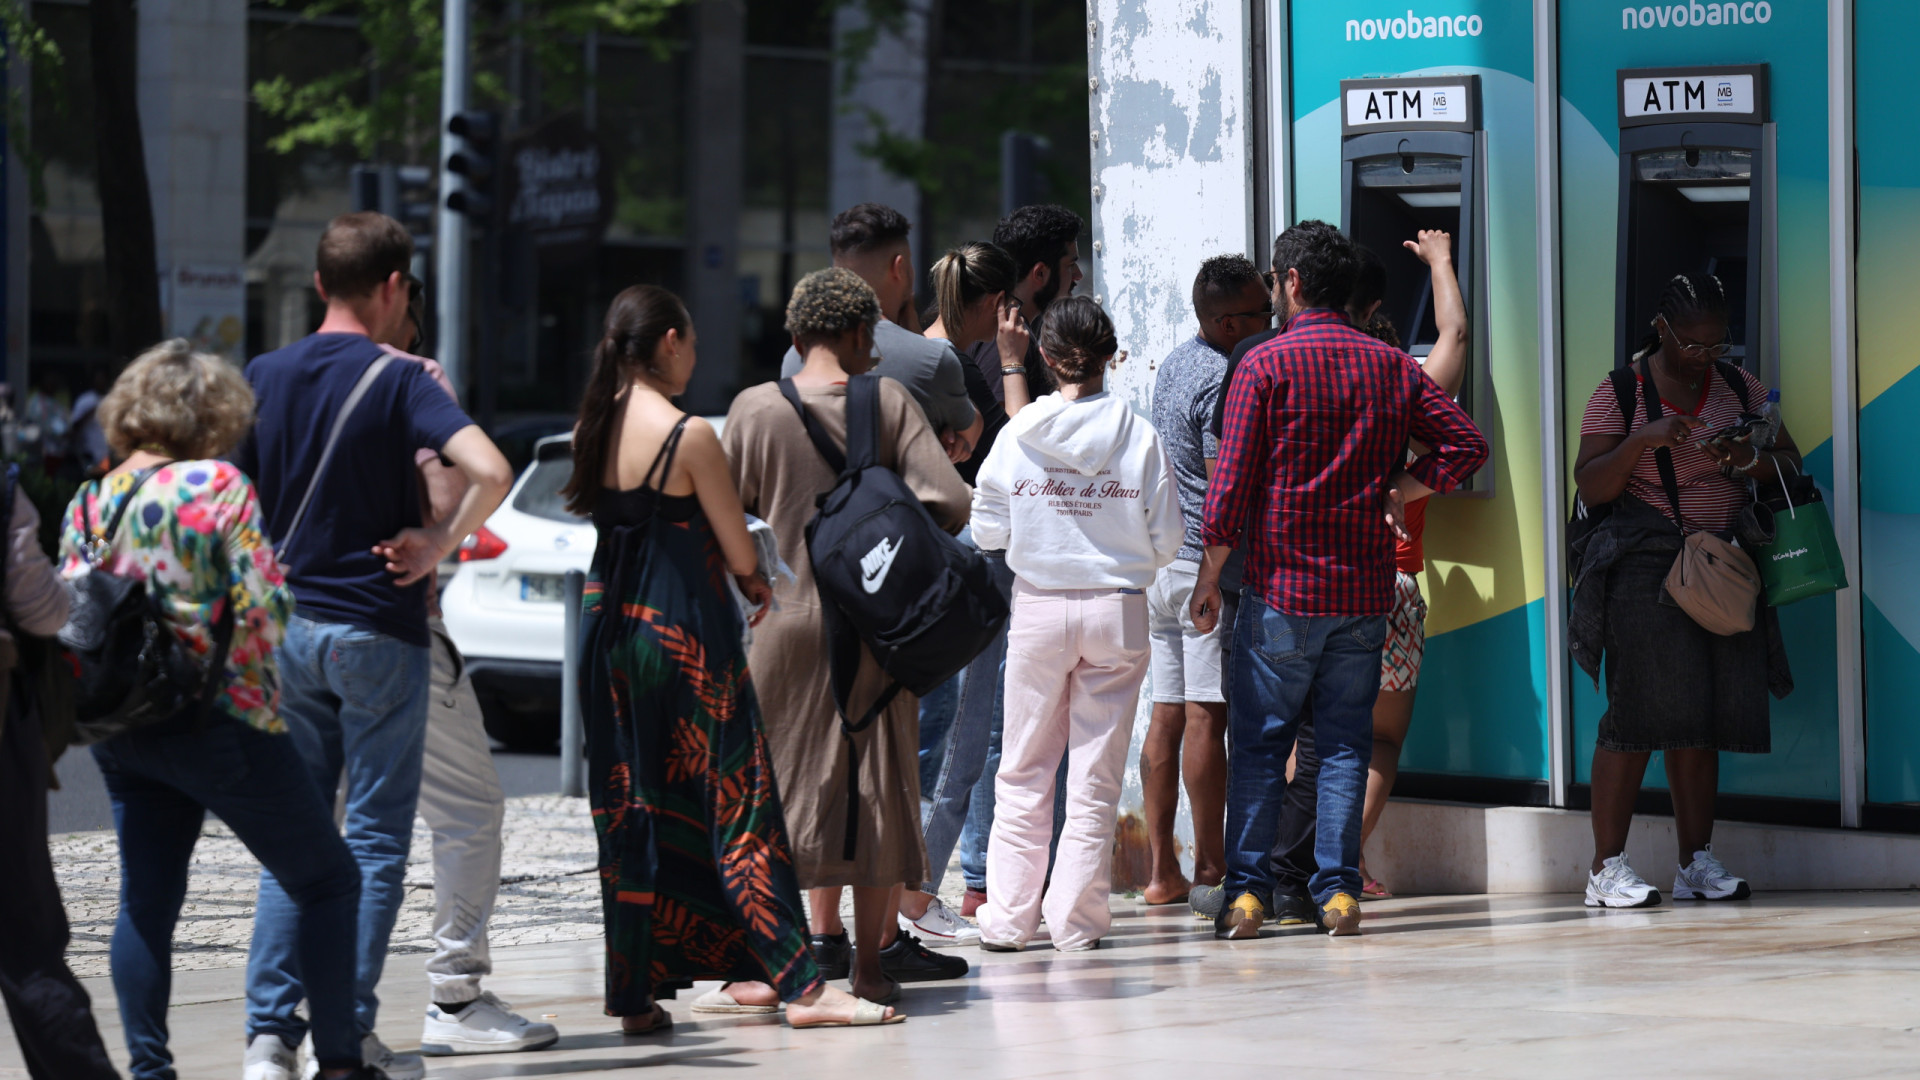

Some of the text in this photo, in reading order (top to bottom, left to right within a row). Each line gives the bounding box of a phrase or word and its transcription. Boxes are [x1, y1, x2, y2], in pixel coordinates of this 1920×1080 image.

[1346, 9, 1483, 42] novobanco
[1622, 0, 1772, 30] novobanco
[1365, 89, 1422, 120] ATM
[1432, 96, 1447, 106] MB
[1643, 80, 1705, 112] ATM
[1717, 87, 1732, 97] MB
[1011, 478, 1140, 499] L'Atelier de Fleurs
[1048, 500, 1061, 508] RUE
[1061, 500, 1074, 508] DES
[1073, 509, 1093, 517] PARIS
[860, 536, 892, 579] NIKE
